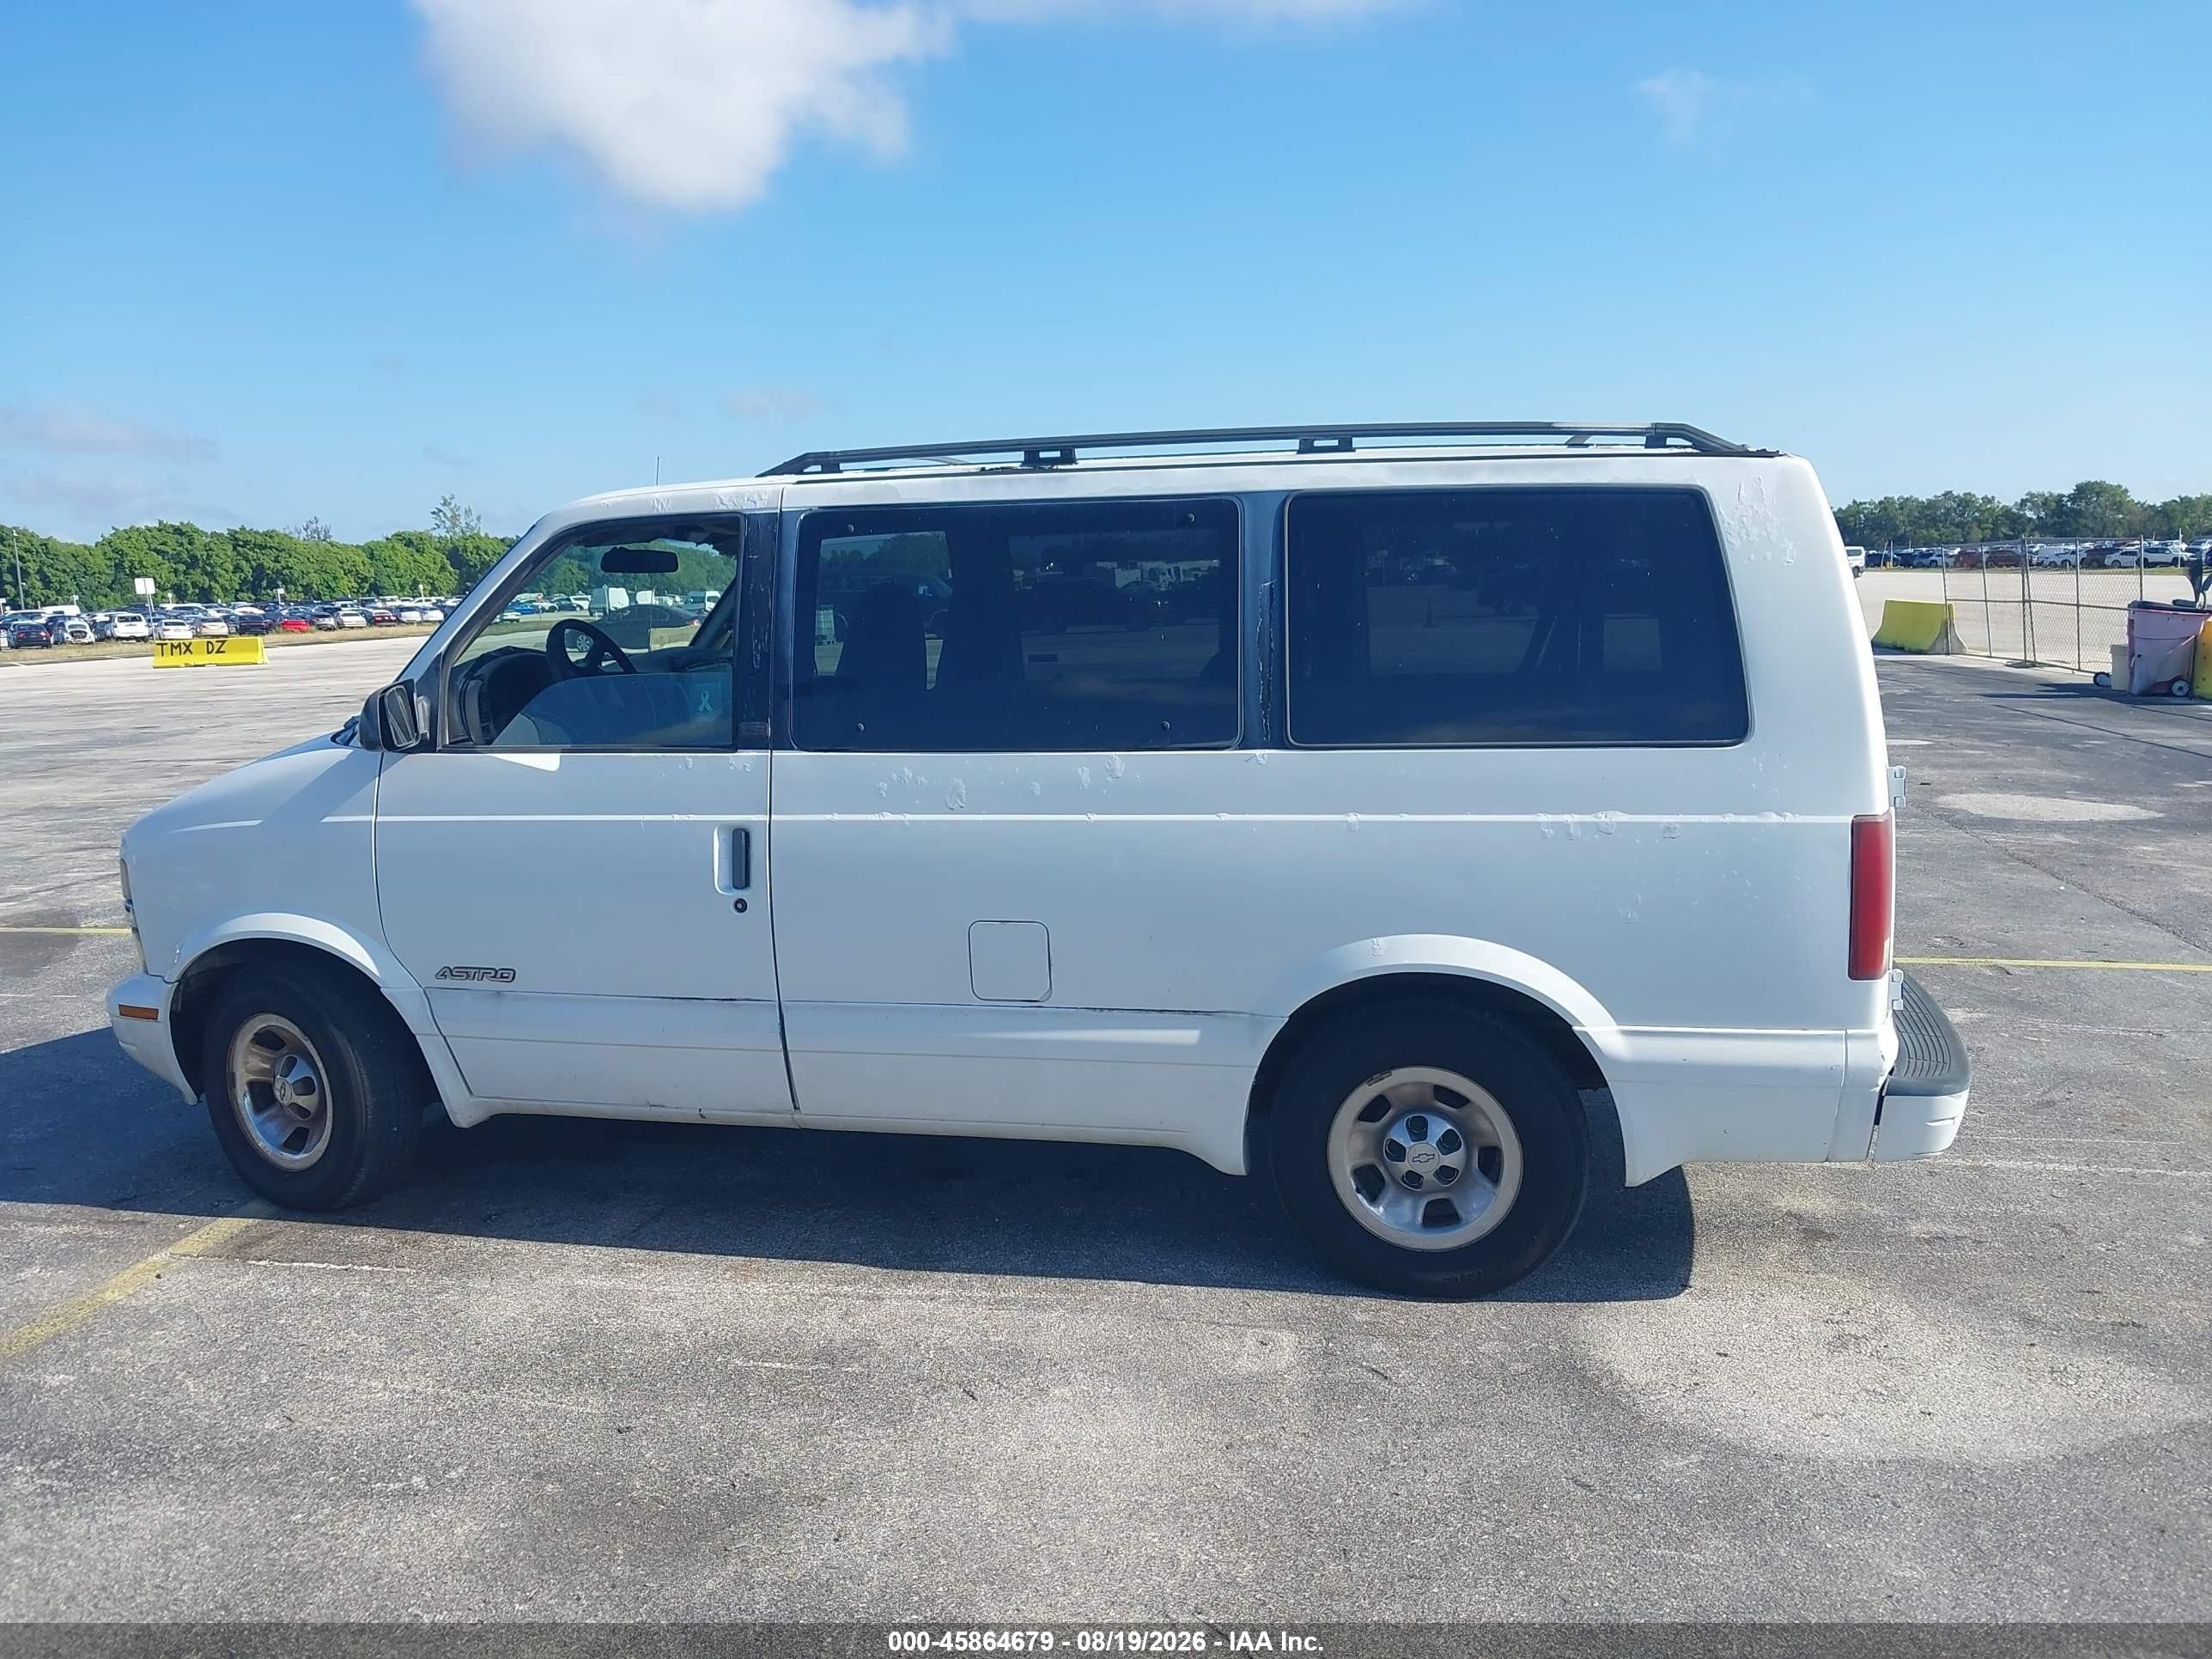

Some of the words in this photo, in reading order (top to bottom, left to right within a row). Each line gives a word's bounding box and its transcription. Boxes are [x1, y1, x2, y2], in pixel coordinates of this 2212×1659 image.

[156, 641, 193, 657] TMX
[206, 640, 228, 655] DZ
[434, 965, 517, 983] ASTRO
